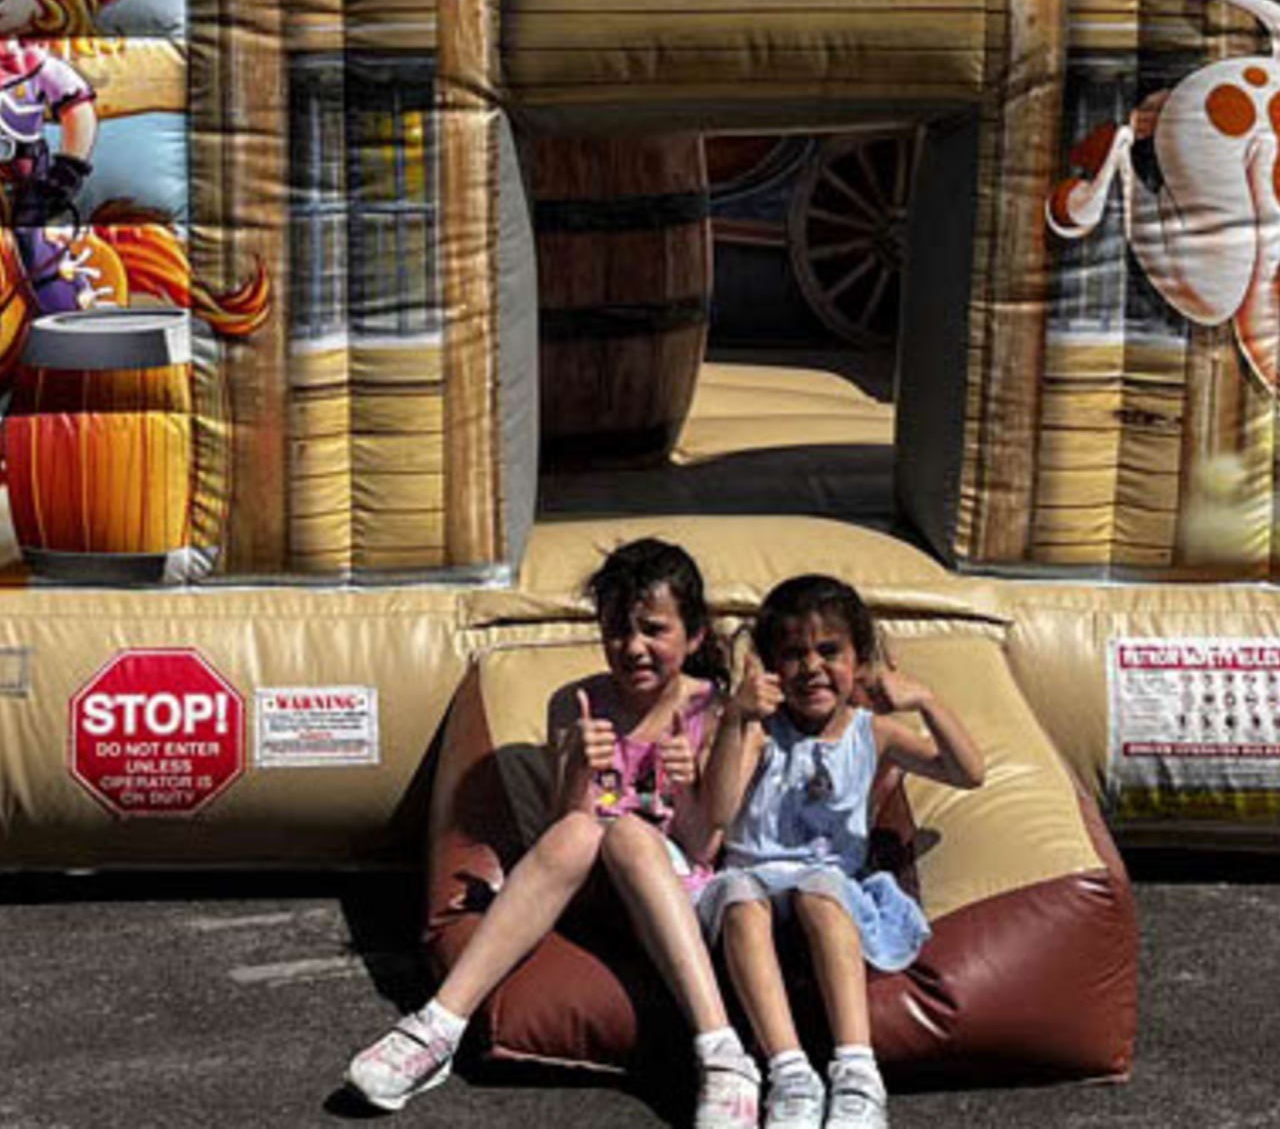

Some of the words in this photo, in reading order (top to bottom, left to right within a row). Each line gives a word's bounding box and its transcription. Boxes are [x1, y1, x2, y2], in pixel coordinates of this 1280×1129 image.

[82, 692, 228, 735] STOP!
[96, 742, 120, 757] DO
[126, 742, 160, 756] NOT
[165, 742, 220, 755] ENTER
[126, 759, 192, 773] UNLESS
[100, 776, 192, 789] OPERATOR
[197, 776, 213, 788] IS
[150, 792, 195, 806] DUTY
